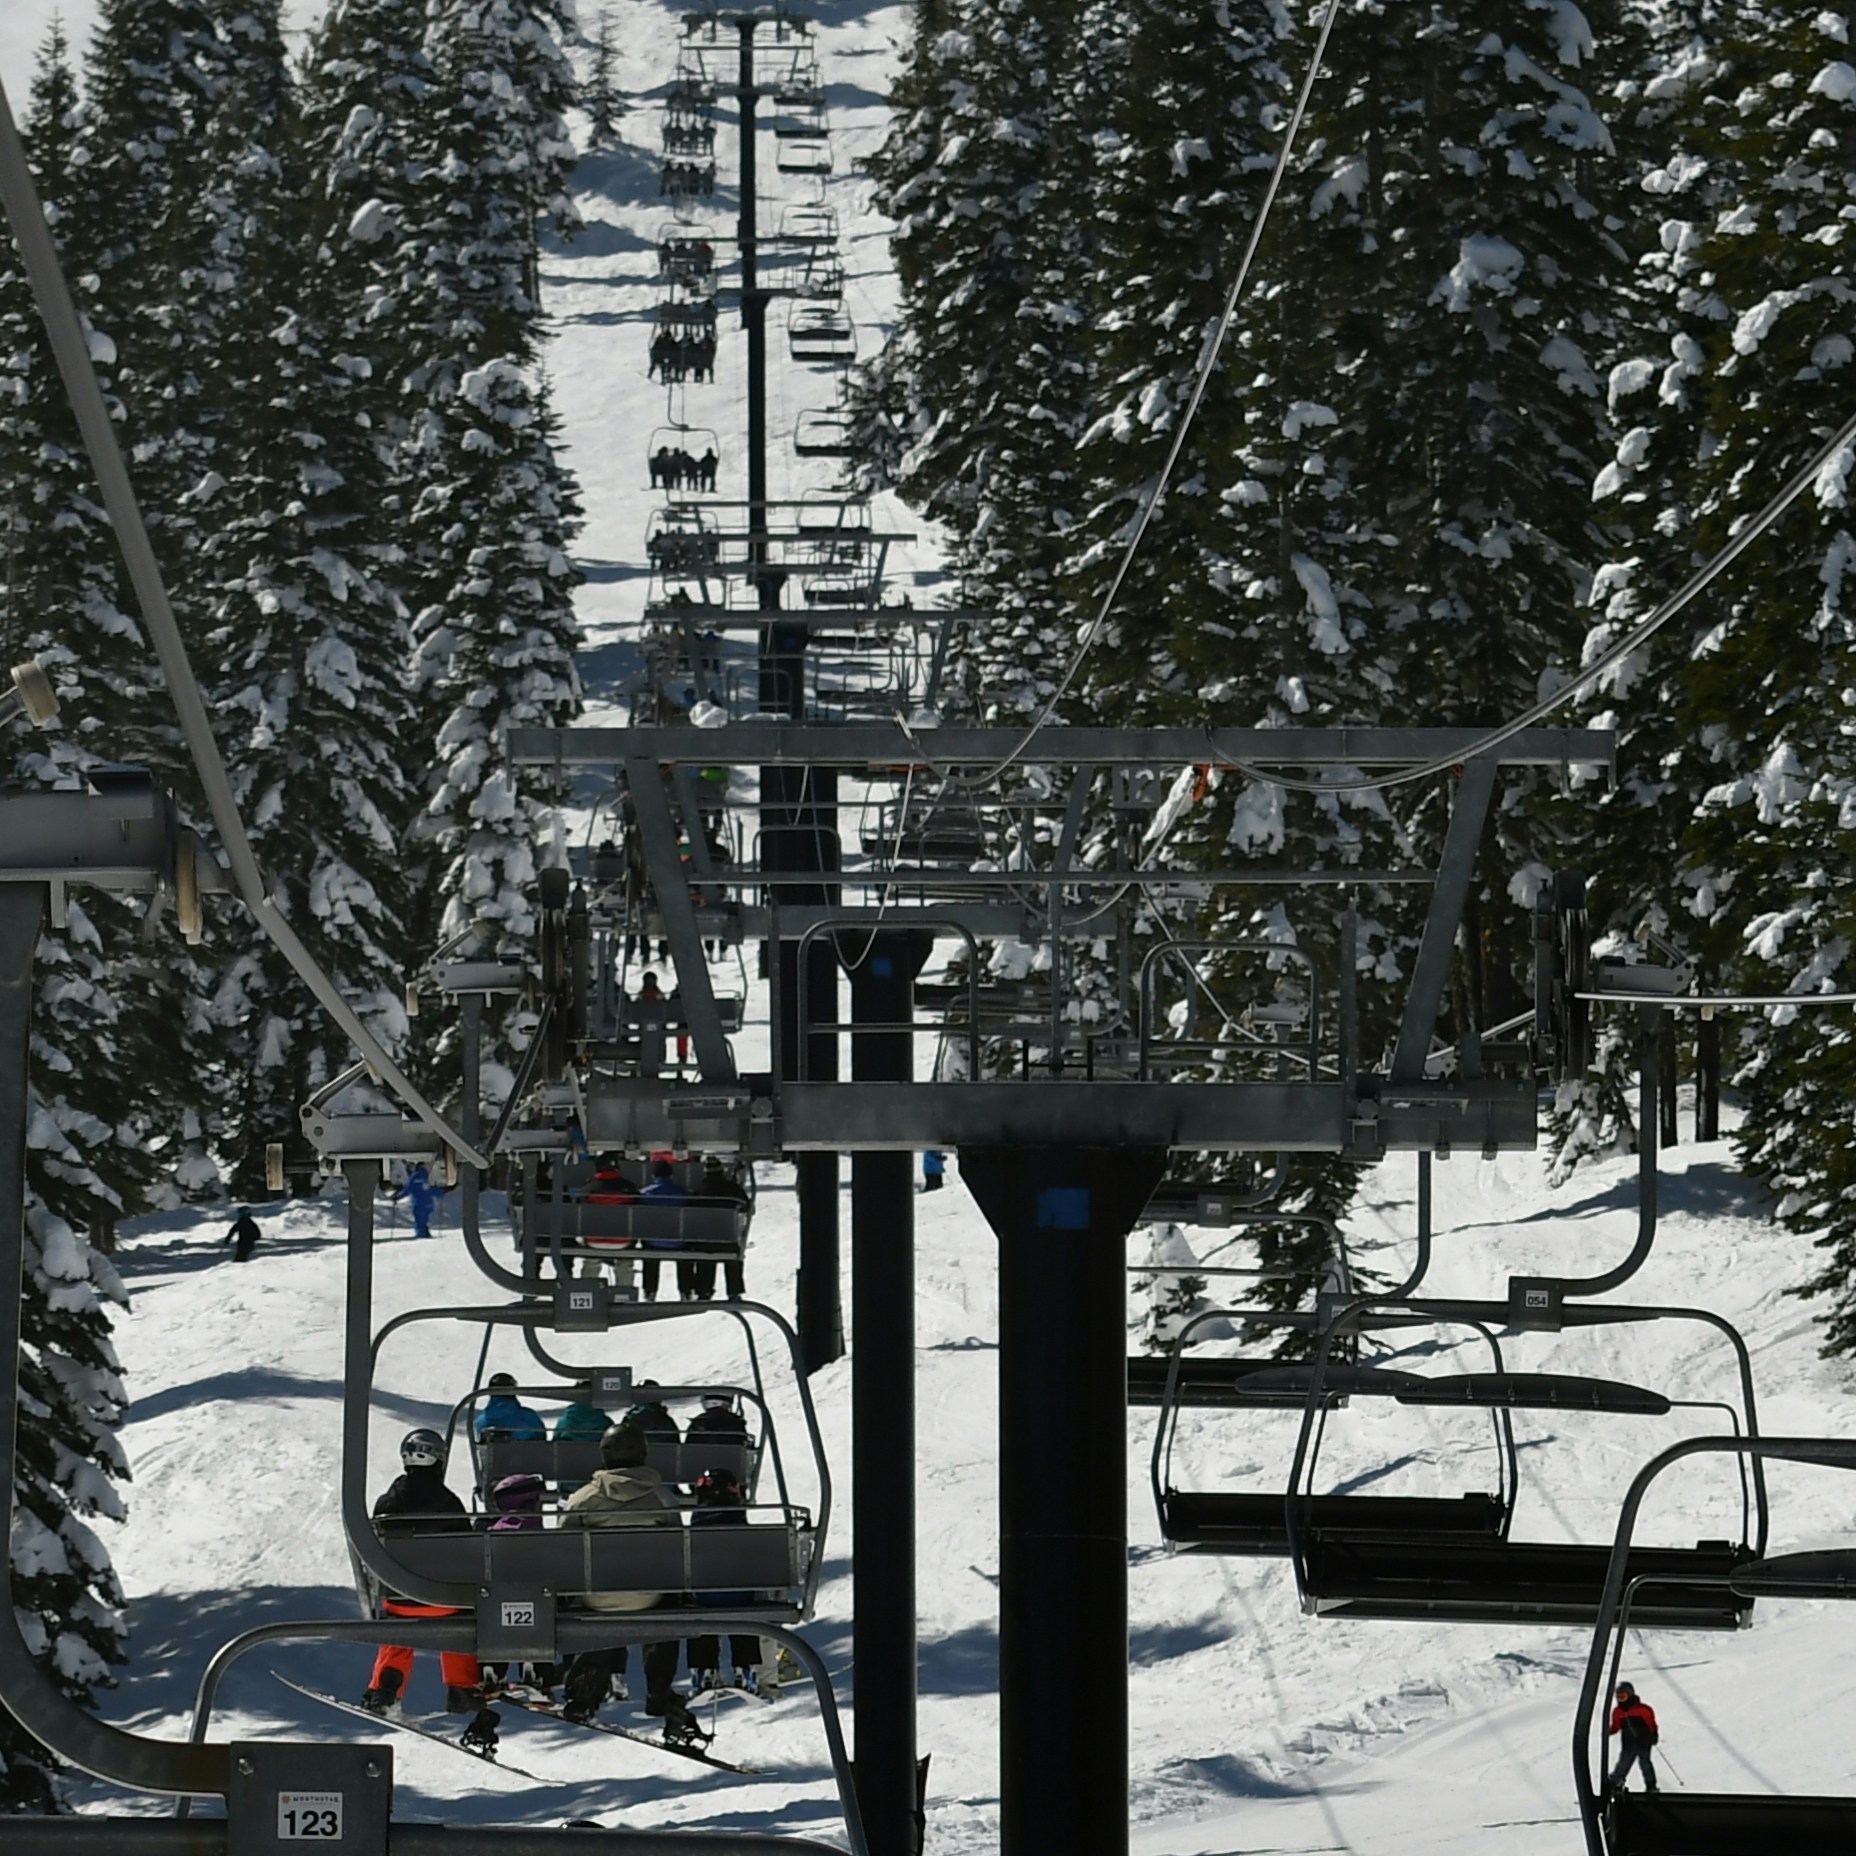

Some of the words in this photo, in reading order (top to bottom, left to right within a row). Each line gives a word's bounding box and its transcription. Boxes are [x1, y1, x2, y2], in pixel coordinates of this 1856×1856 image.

[573, 1298, 590, 1307] 121
[1528, 1296, 1546, 1305] 054
[505, 1611, 532, 1625] 122
[284, 1810, 338, 1836] 123
